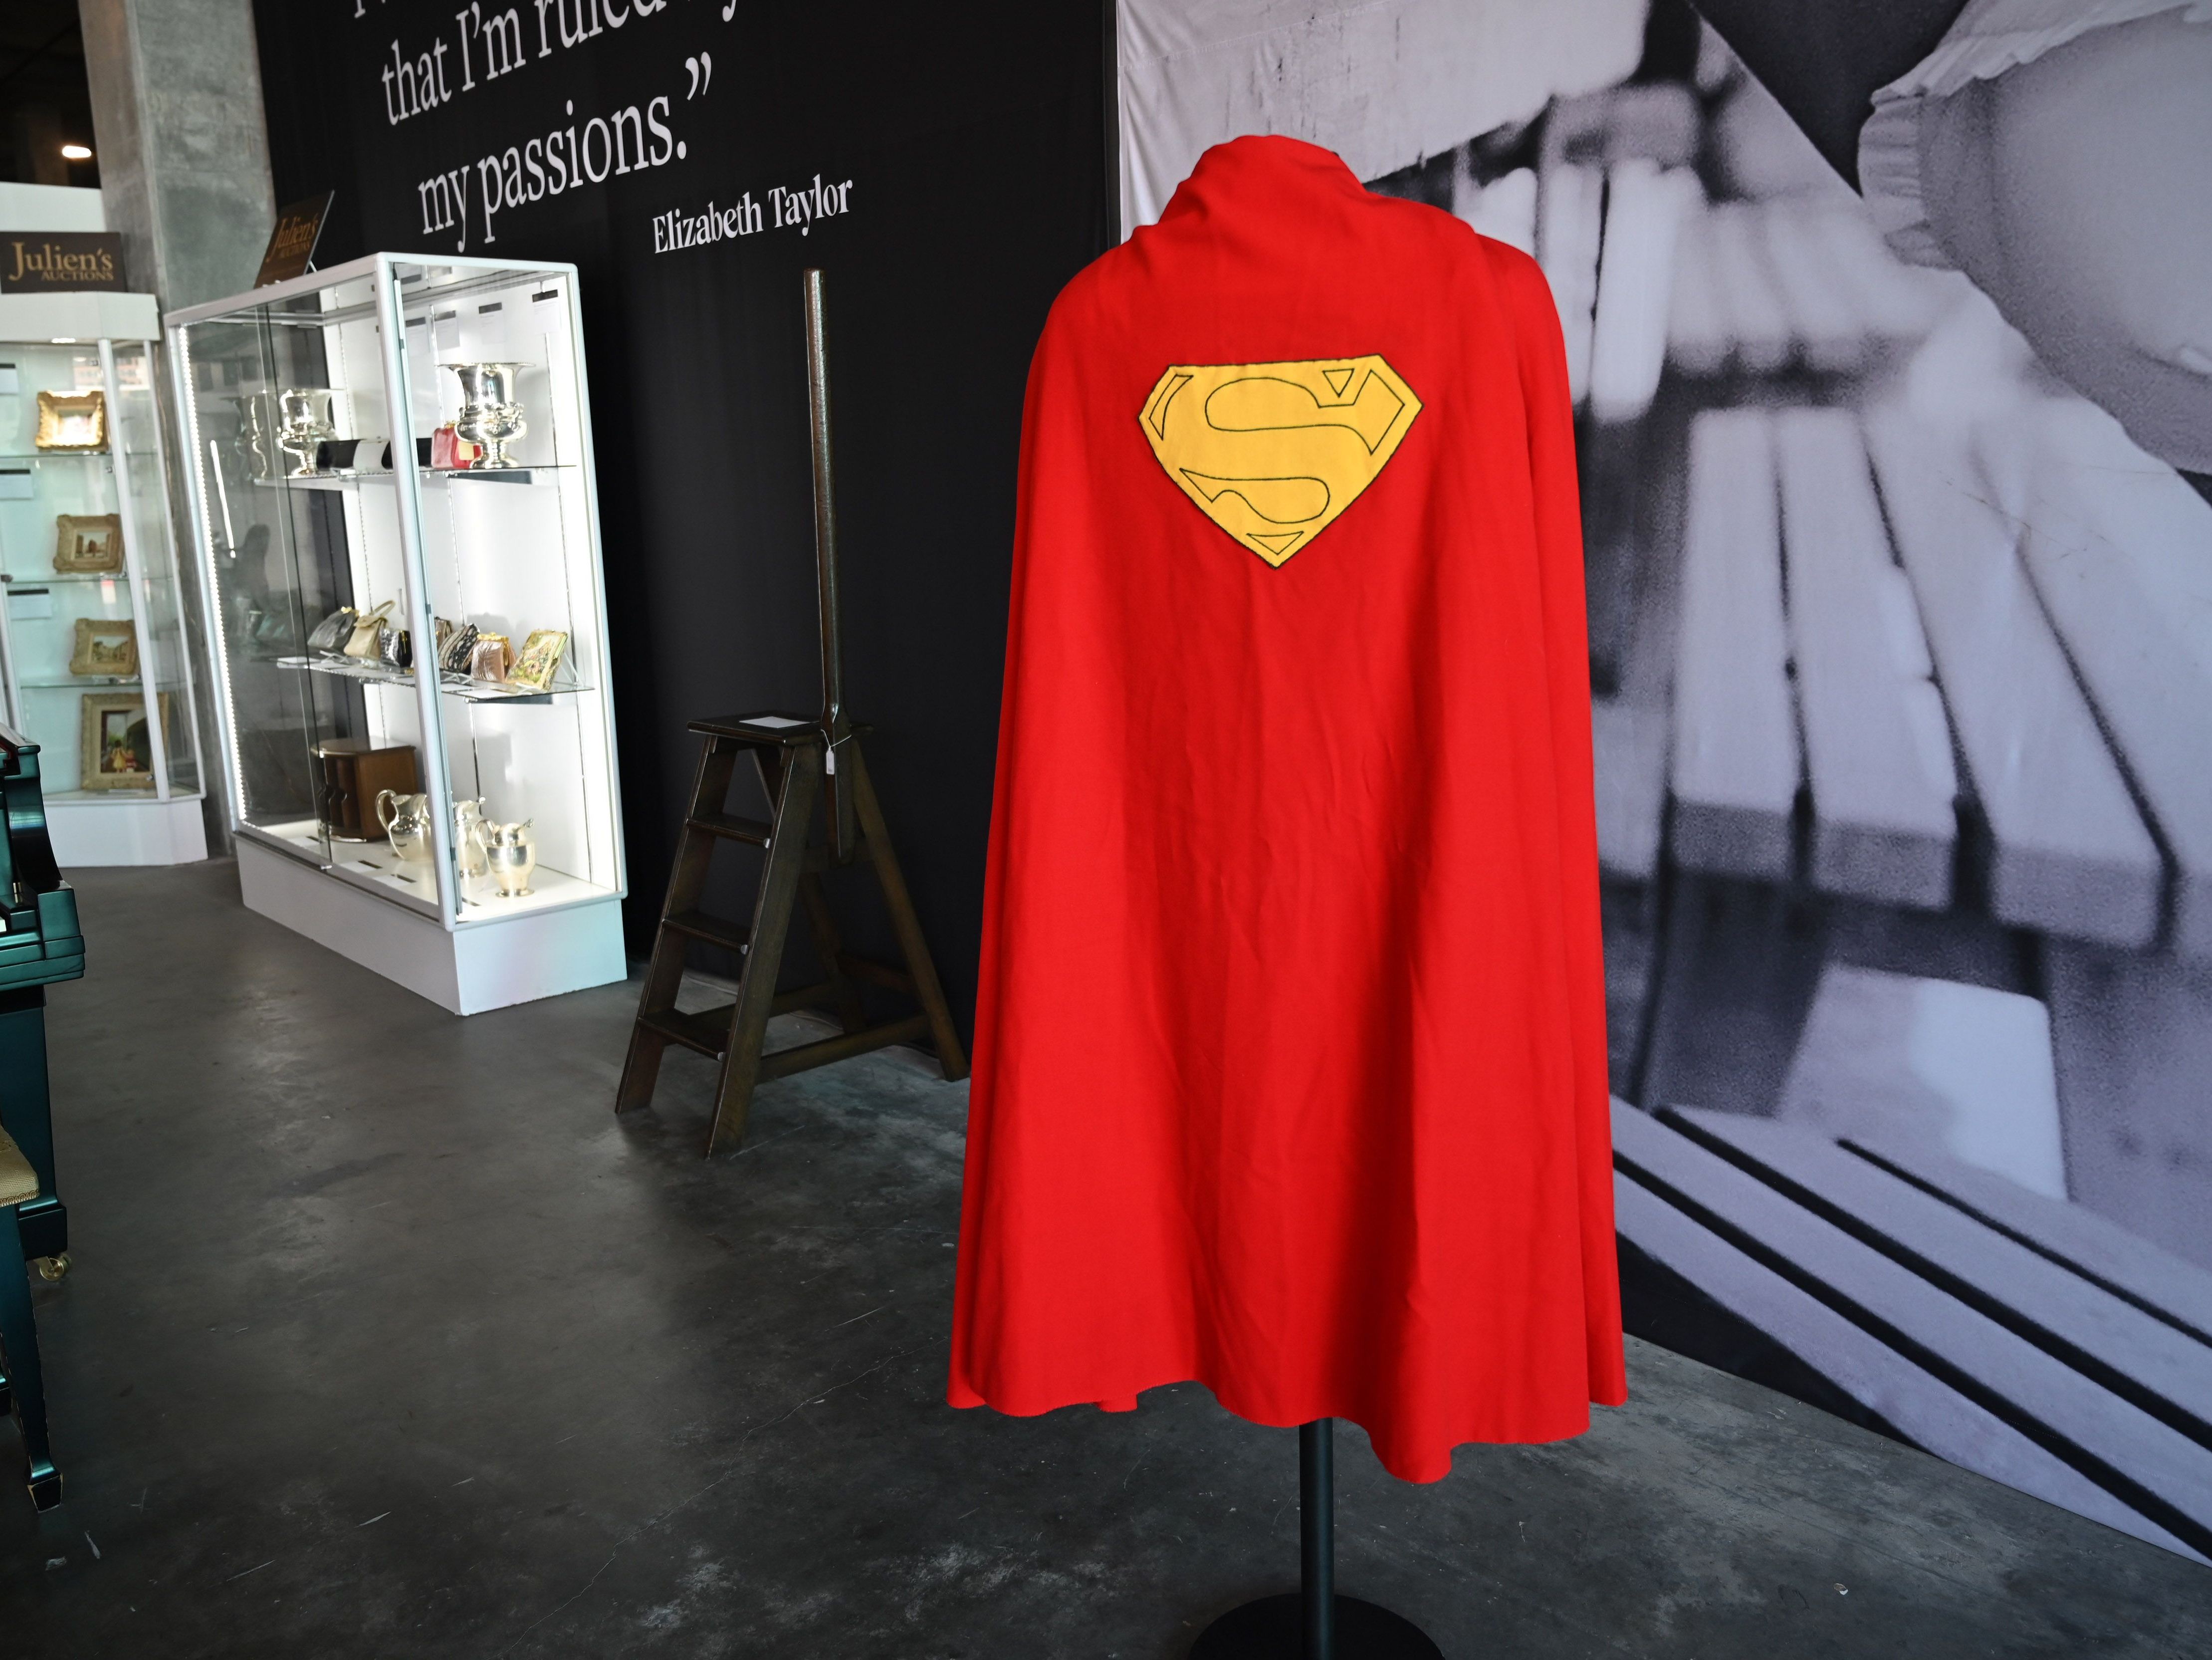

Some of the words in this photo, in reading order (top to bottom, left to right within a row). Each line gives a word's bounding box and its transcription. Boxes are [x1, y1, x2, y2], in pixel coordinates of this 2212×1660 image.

[382, 39, 452, 125] that
[456, 1, 526, 92] I’m
[418, 165, 470, 253] my
[652, 191, 764, 254] Elizabeth
[768, 174, 853, 237] Taylor
[8, 242, 113, 281] Julien's
[41, 270, 114, 281] AUCTIONS
